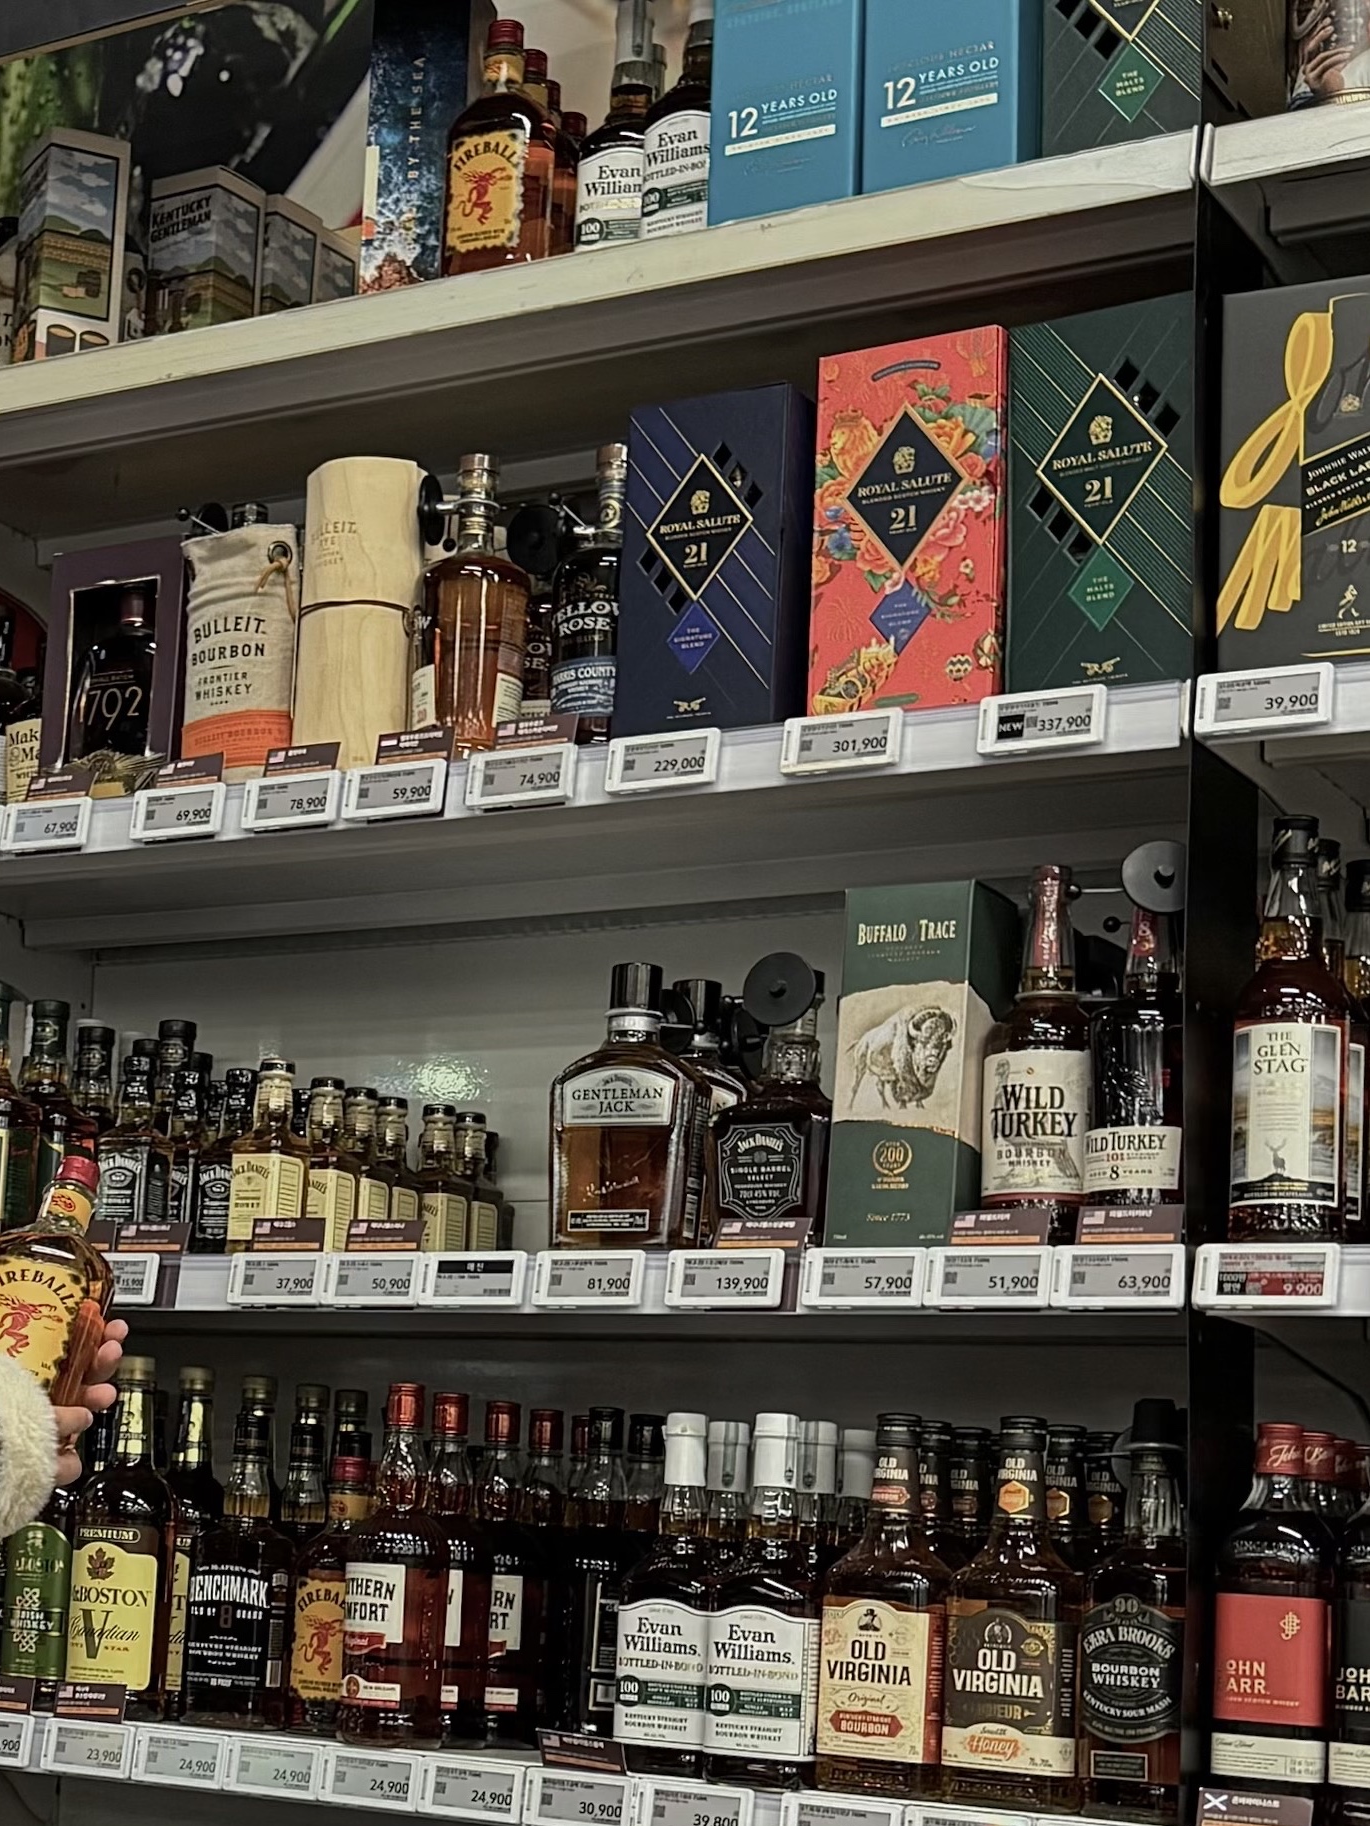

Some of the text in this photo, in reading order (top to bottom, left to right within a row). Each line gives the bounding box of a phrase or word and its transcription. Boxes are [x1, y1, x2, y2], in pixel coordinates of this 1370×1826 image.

[883, 77, 917, 110] 12
[919, 66, 965, 84] YEARS
[969, 56, 1000, 73] OLD
[728, 88, 838, 139] 12 YEARS OLD
[658, 128, 698, 148] Evan
[453, 140, 520, 171] FIREBALL
[598, 164, 642, 181] Evan
[151, 195, 212, 230] KENTUCKY
[150, 209, 212, 244] GENTLEMAN
[580, 221, 601, 235] 100
[857, 471, 953, 498] ROYAL SALUTE
[659, 513, 741, 535] ROYAL SALUTE
[889, 504, 917, 530] 21
[684, 542, 708, 565] 21
[1341, 539, 1357, 554] 12
[558, 617, 613, 637] ROSE
[191, 643, 266, 666] BOURBON
[197, 671, 249, 687] FRONTIER
[194, 683, 252, 701] WHISKEY
[1264, 694, 1319, 711] 39,900
[998, 721, 1024, 733] NEW
[1037, 714, 1092, 732] 337,900
[831, 735, 887, 754] 301,900
[653, 756, 705, 774] 229,000
[519, 771, 560, 786] 74,900
[393, 785, 431, 800] 59,900
[290, 796, 328, 811] 78,900
[176, 807, 212, 822] 69,900
[43, 821, 78, 835] 67,900
[856, 917, 957, 946] BUFFALO TRACE
[1257, 1042, 1301, 1058] GLEN
[1253, 1057, 1307, 1075] STAG
[571, 1087, 664, 1101] GENTLEMAN
[1001, 1083, 1065, 1111] WILD
[597, 1101, 635, 1115] JACK
[990, 1110, 1078, 1140] TURKEY
[879, 1146, 905, 1163] 200
[996, 1147, 1067, 1160] BOURBON
[1109, 1165, 1120, 1181] 8
[1122, 1167, 1154, 1177] YEARS
[275, 1276, 314, 1291] 37,900
[371, 1276, 411, 1291] 50,900
[586, 1277, 631, 1291] 81,900
[715, 1276, 769, 1291] 139,900
[864, 1274, 914, 1293] 57,900
[988, 1275, 1040, 1290] 51,900
[1117, 1275, 1172, 1290] 63,900
[1282, 1282, 1323, 1297] 9,900
[79, 1527, 134, 1541] PREMIUM
[849, 1638, 887, 1661] OLD
[1082, 1624, 1176, 1659] EZRA BROOKS
[976, 1648, 1017, 1671] OLD
[825, 1658, 912, 1687] VIRGINIA
[951, 1668, 1045, 1699] VIRGINIA
[846, 1691, 887, 1707] Original
[965, 1733, 1019, 1757] Honey
[86, 1748, 123, 1763] 23,900
[179, 1758, 216, 1774] 24,900
[273, 1767, 312, 1785] 24,900
